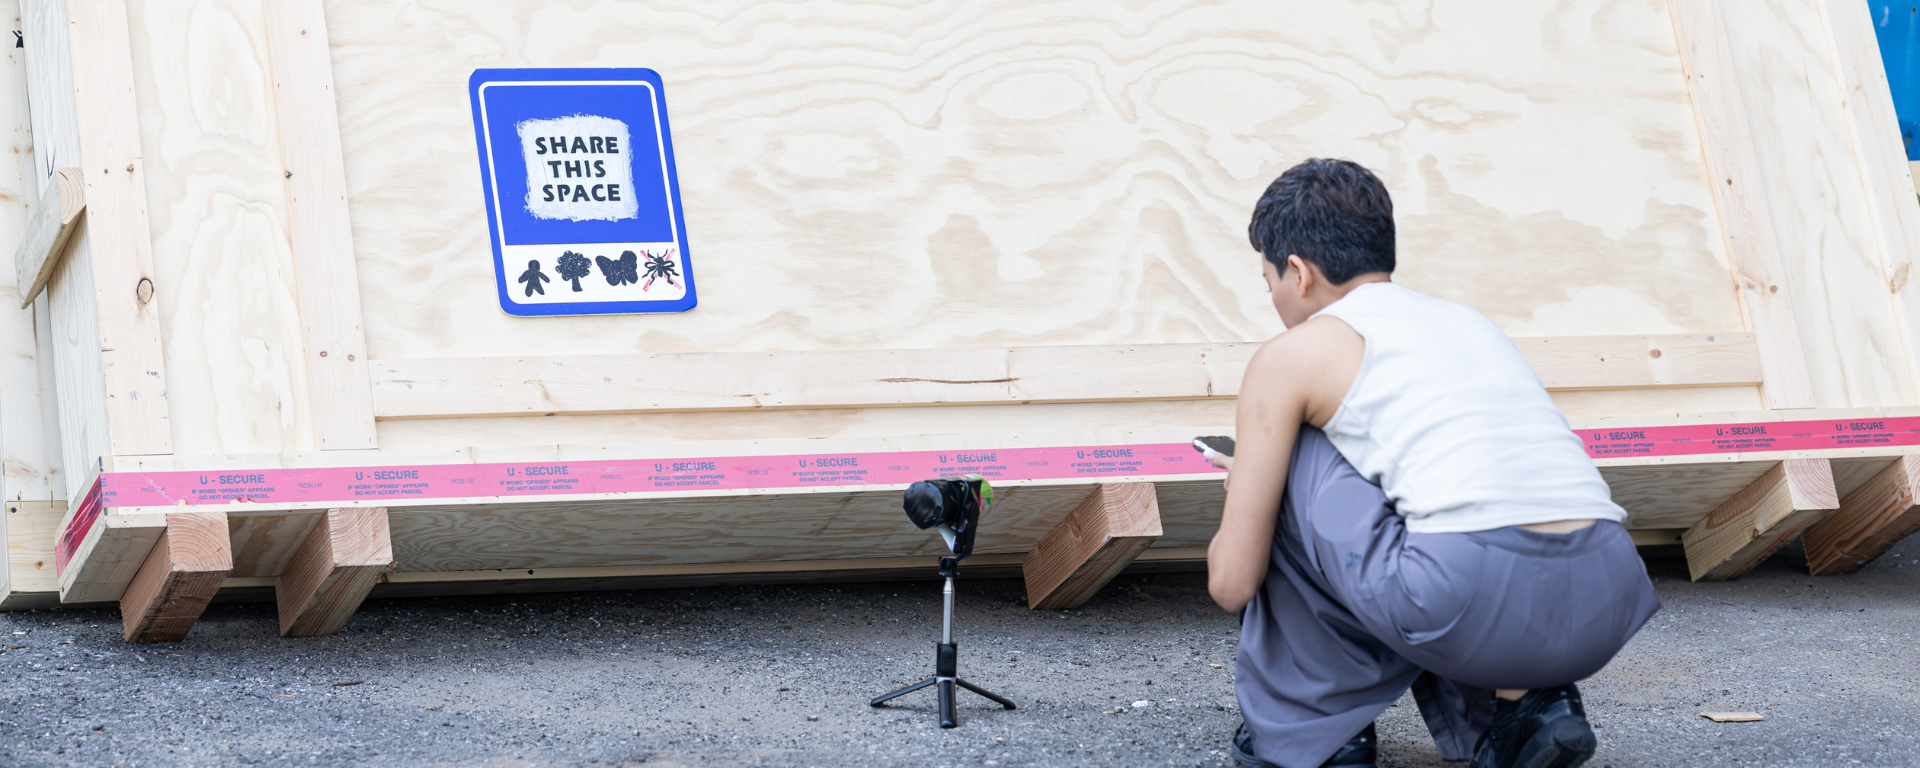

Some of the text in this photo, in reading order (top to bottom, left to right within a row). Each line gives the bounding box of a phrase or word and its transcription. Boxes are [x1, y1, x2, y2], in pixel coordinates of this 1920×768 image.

[535, 136, 619, 154] SHARE
[547, 160, 606, 178] THIS
[542, 184, 621, 202] SPACE
[1716, 428, 1723, 436] U
[1730, 426, 1767, 436] SECURE
[1835, 423, 1842, 431] U
[1849, 422, 1885, 431] SECURE
[1594, 433, 1601, 441] U
[1608, 431, 1646, 440] SECURE
[939, 455, 947, 463] U
[956, 454, 998, 463] SECURE
[1076, 451, 1084, 459] U
[1093, 449, 1134, 458] SECURE
[654, 463, 662, 472] U
[672, 462, 716, 472] SECURE
[799, 459, 806, 468] U
[816, 458, 858, 467] SECURE
[355, 472, 363, 481] U
[374, 470, 419, 480] SECURE
[507, 467, 515, 476] U
[525, 466, 569, 476] SECURE
[200, 476, 208, 485] U
[218, 474, 265, 484] SECURE
